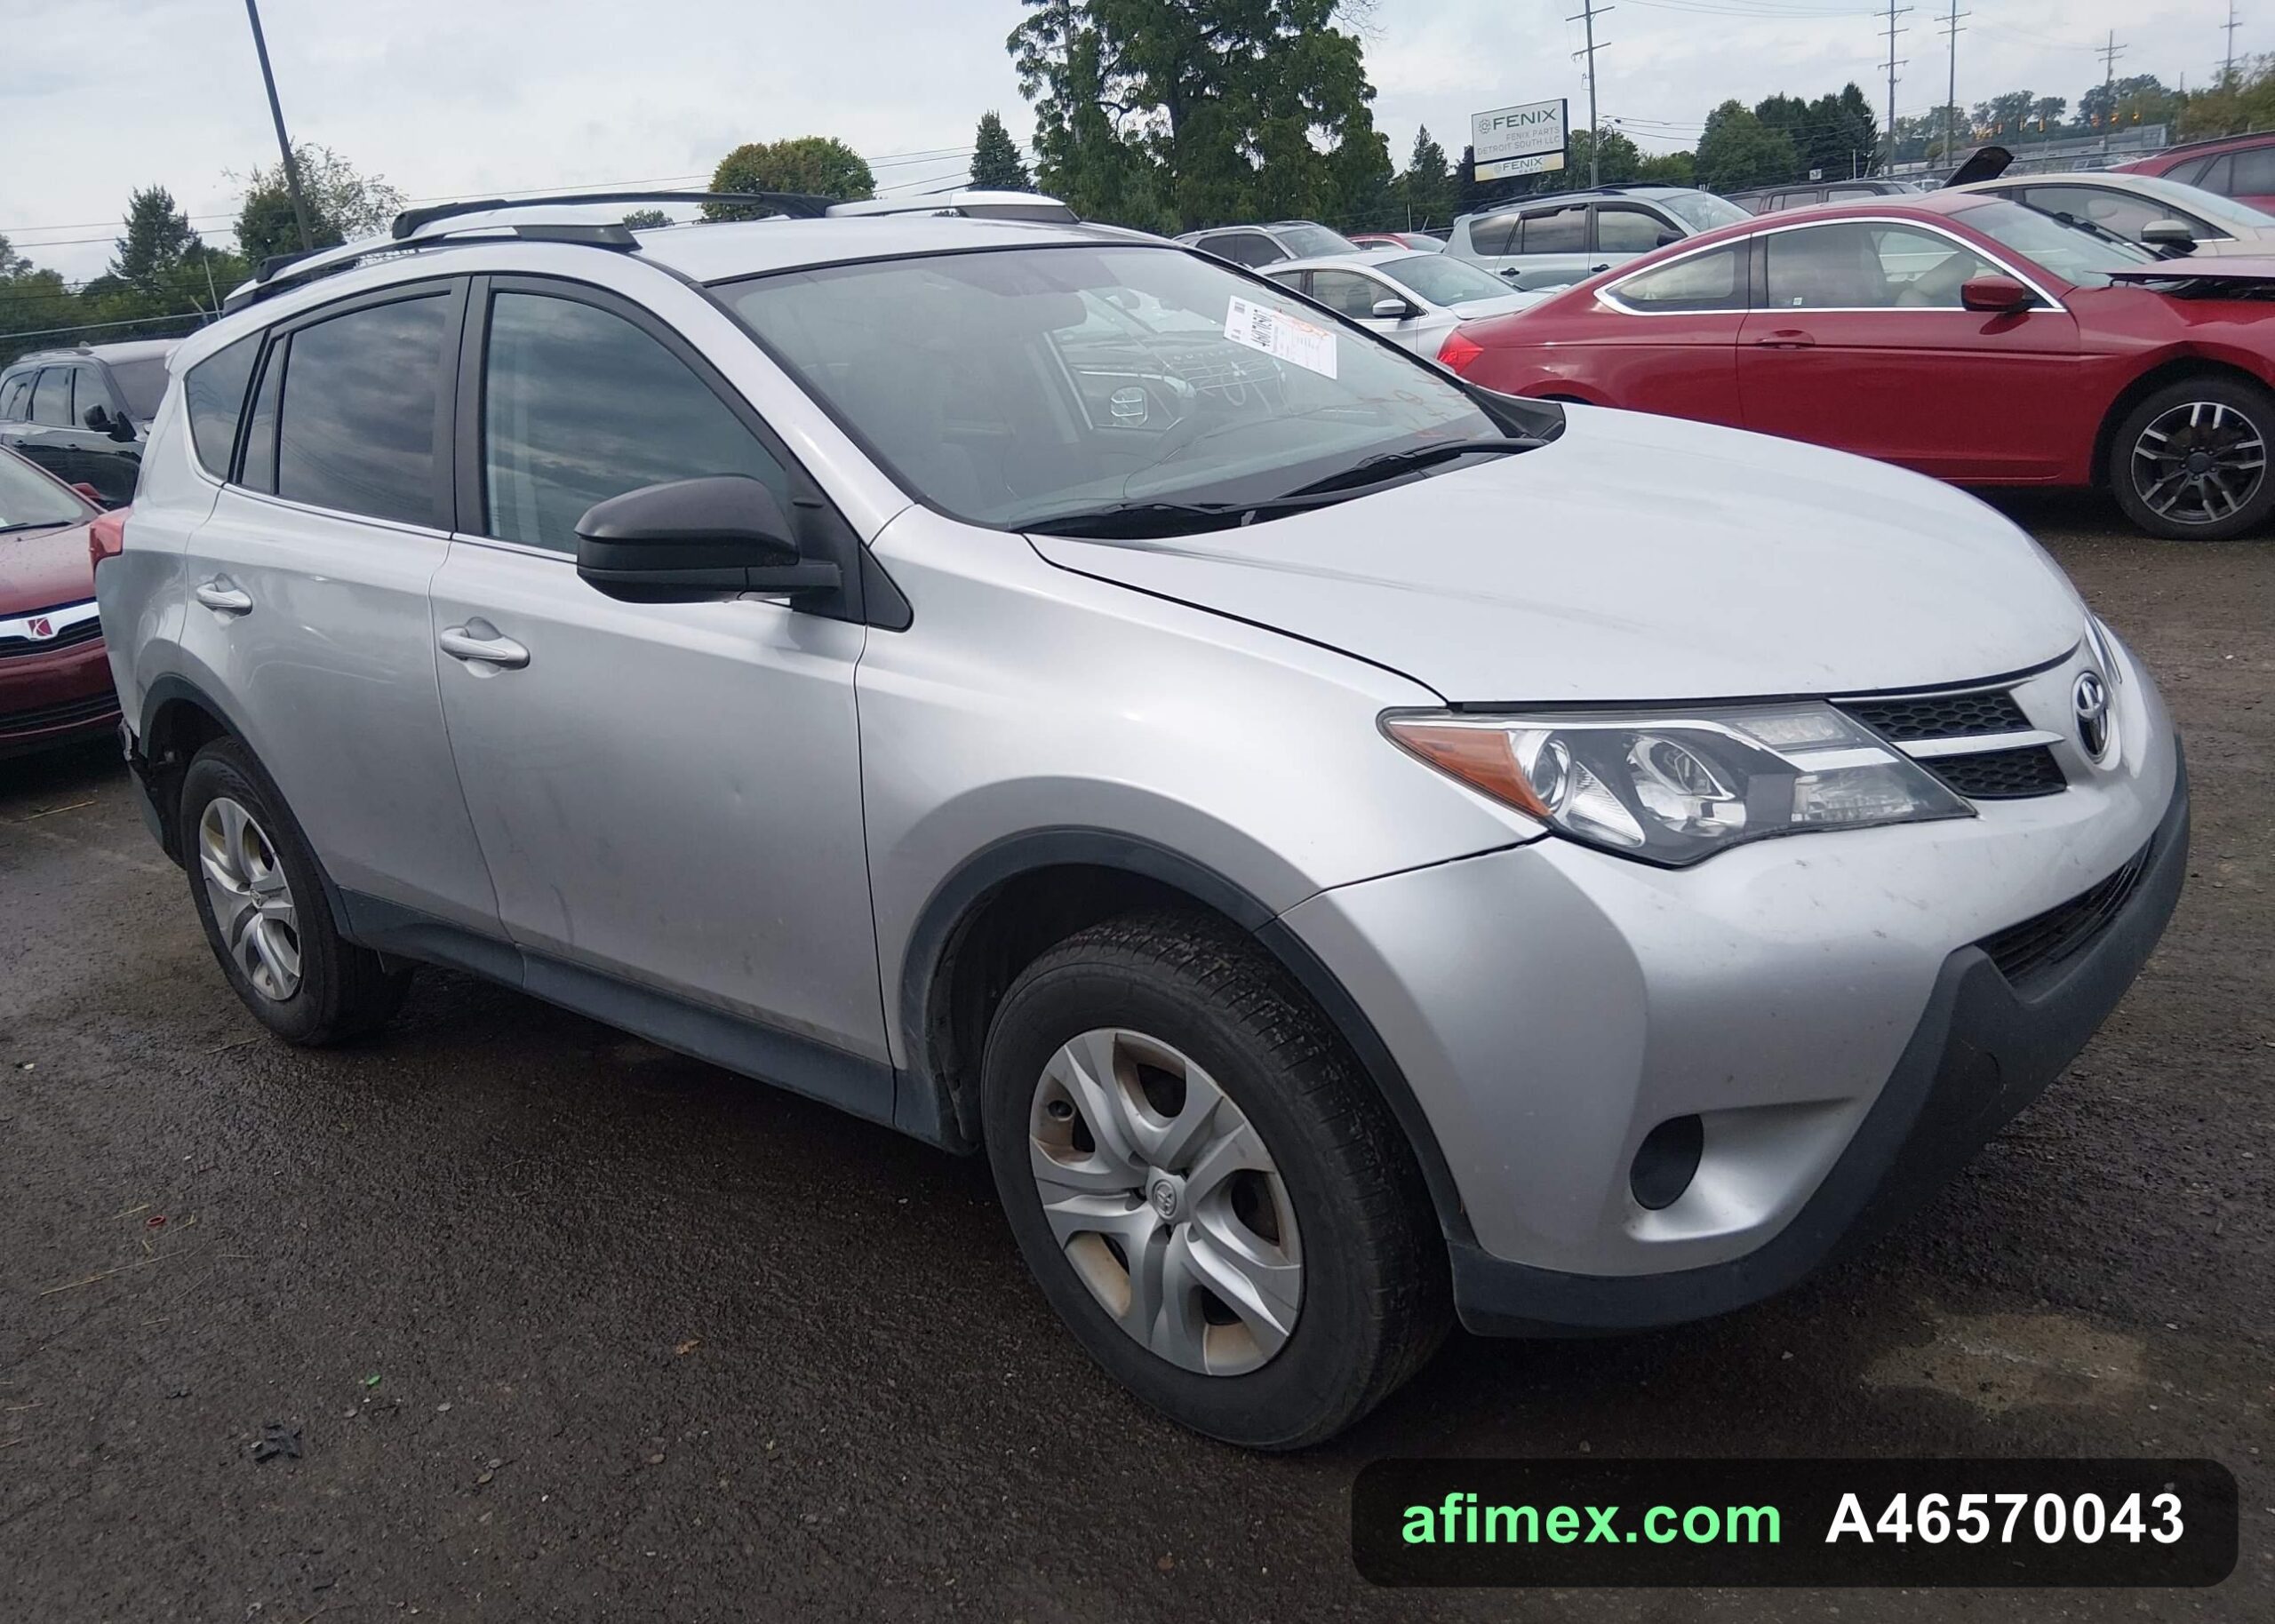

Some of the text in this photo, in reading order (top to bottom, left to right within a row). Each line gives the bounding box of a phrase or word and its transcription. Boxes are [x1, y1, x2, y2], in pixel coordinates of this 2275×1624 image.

[1493, 108, 1556, 130] FENIX
[1506, 126, 1560, 141] FENIX PARTS
[1478, 136, 1560, 155] DETROIT SOUTH LLC
[1503, 157, 1543, 171] FENIX
